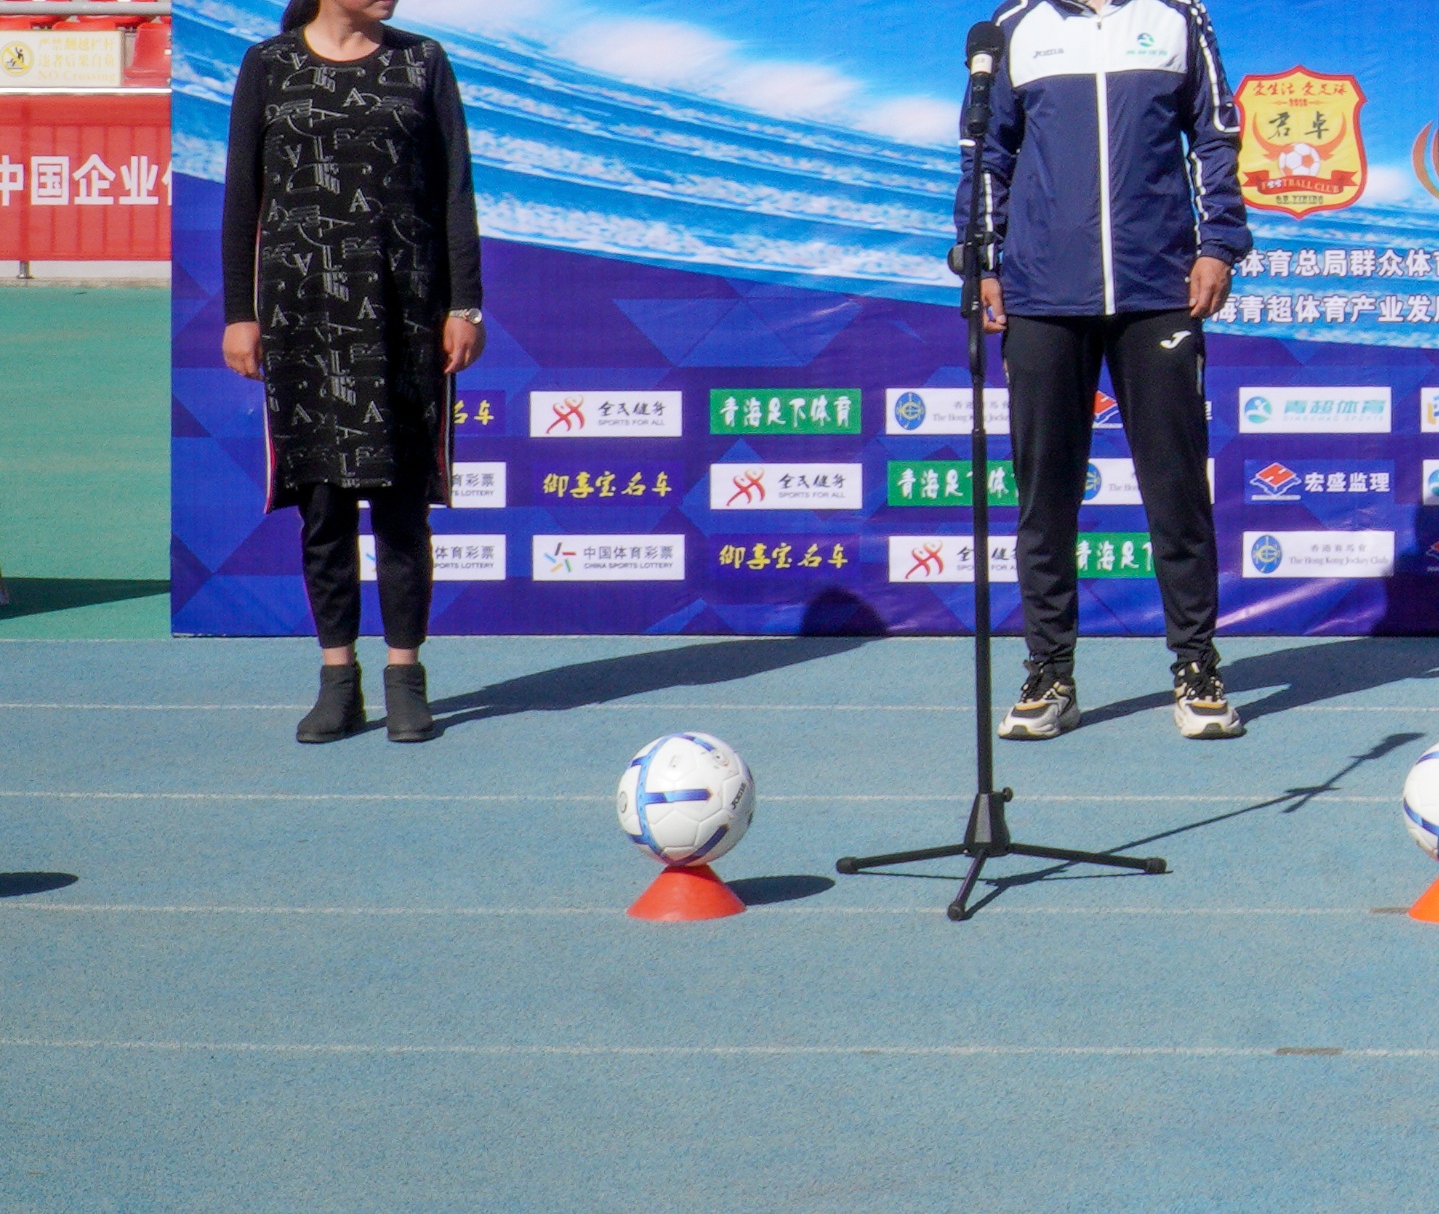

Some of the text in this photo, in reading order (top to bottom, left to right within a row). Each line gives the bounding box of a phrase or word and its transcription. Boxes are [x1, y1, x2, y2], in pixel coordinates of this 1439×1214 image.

[598, 401, 666, 417] 全民健身
[719, 395, 852, 429] 青海足下体育
[1283, 399, 1386, 415] 青超体育
[598, 418, 665, 426] SPORTS FOR ALL
[543, 472, 672, 498] 御享宝名车
[778, 474, 846, 490] 全民健身
[1305, 472, 1390, 493] 宏盛监理
[462, 490, 495, 498] LOTTERY
[778, 491, 845, 499] SPORTS FOR ALL
[583, 545, 674, 561] 中国体育彩票
[719, 543, 849, 571] 御享宝名车
[461, 562, 495, 570] LOTTERY
[583, 562, 674, 570] CHINA SPORTS LOTTERY
